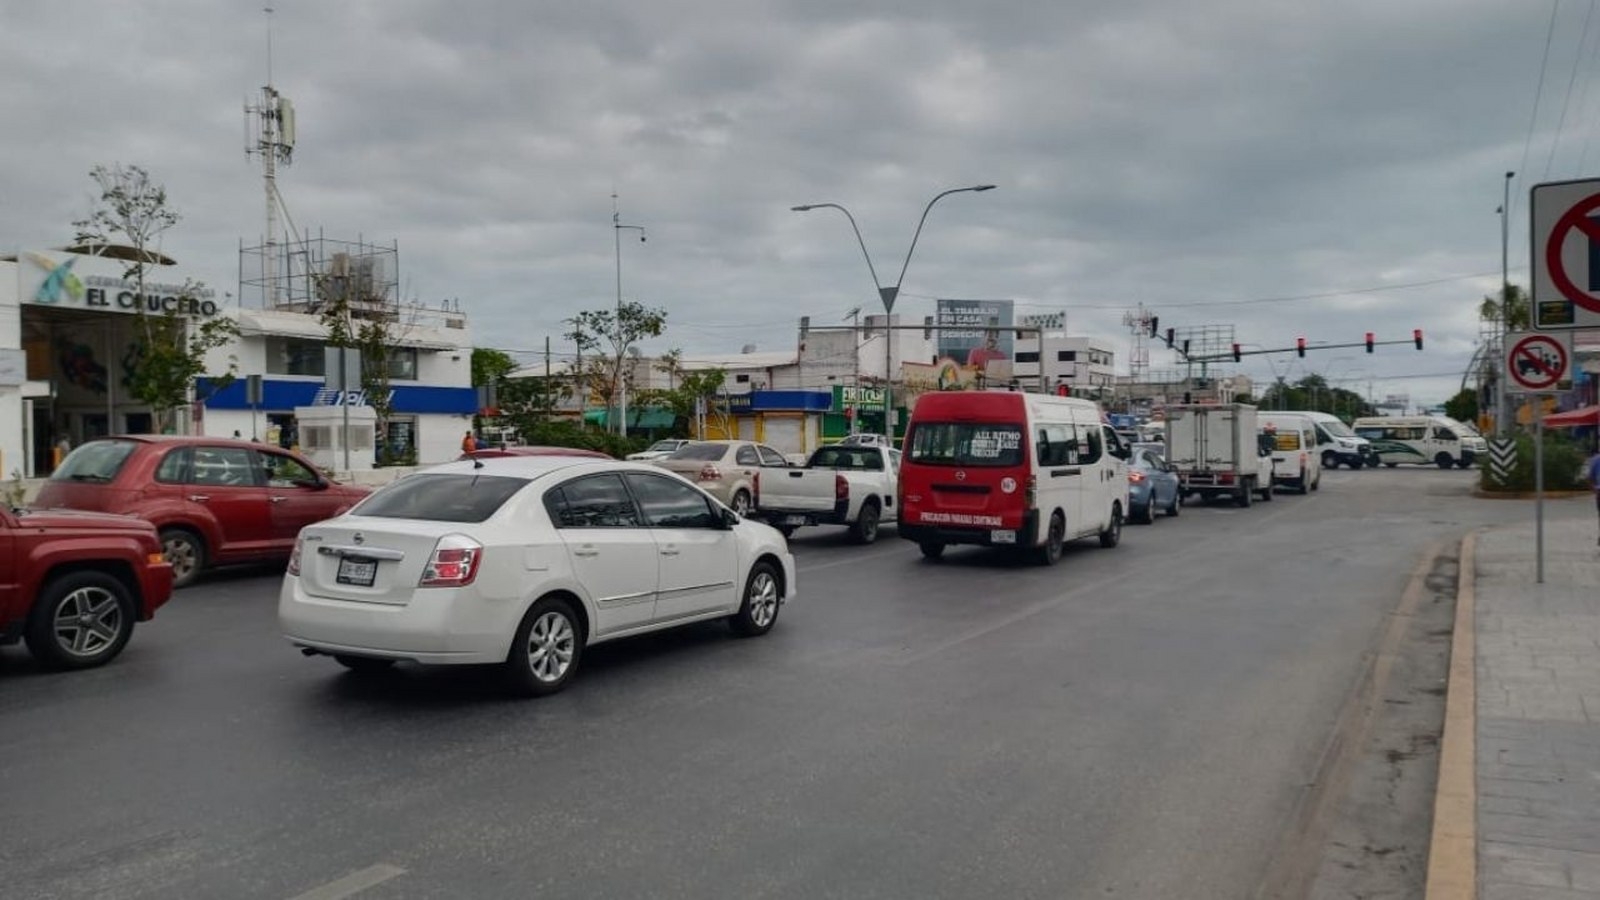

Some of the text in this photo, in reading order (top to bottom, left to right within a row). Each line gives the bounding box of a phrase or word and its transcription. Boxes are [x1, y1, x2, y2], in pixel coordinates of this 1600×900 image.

[87, 288, 110, 306] EL
[941, 307, 998, 315] EL TRABAJO
[975, 431, 1021, 440] ALL RITMO
